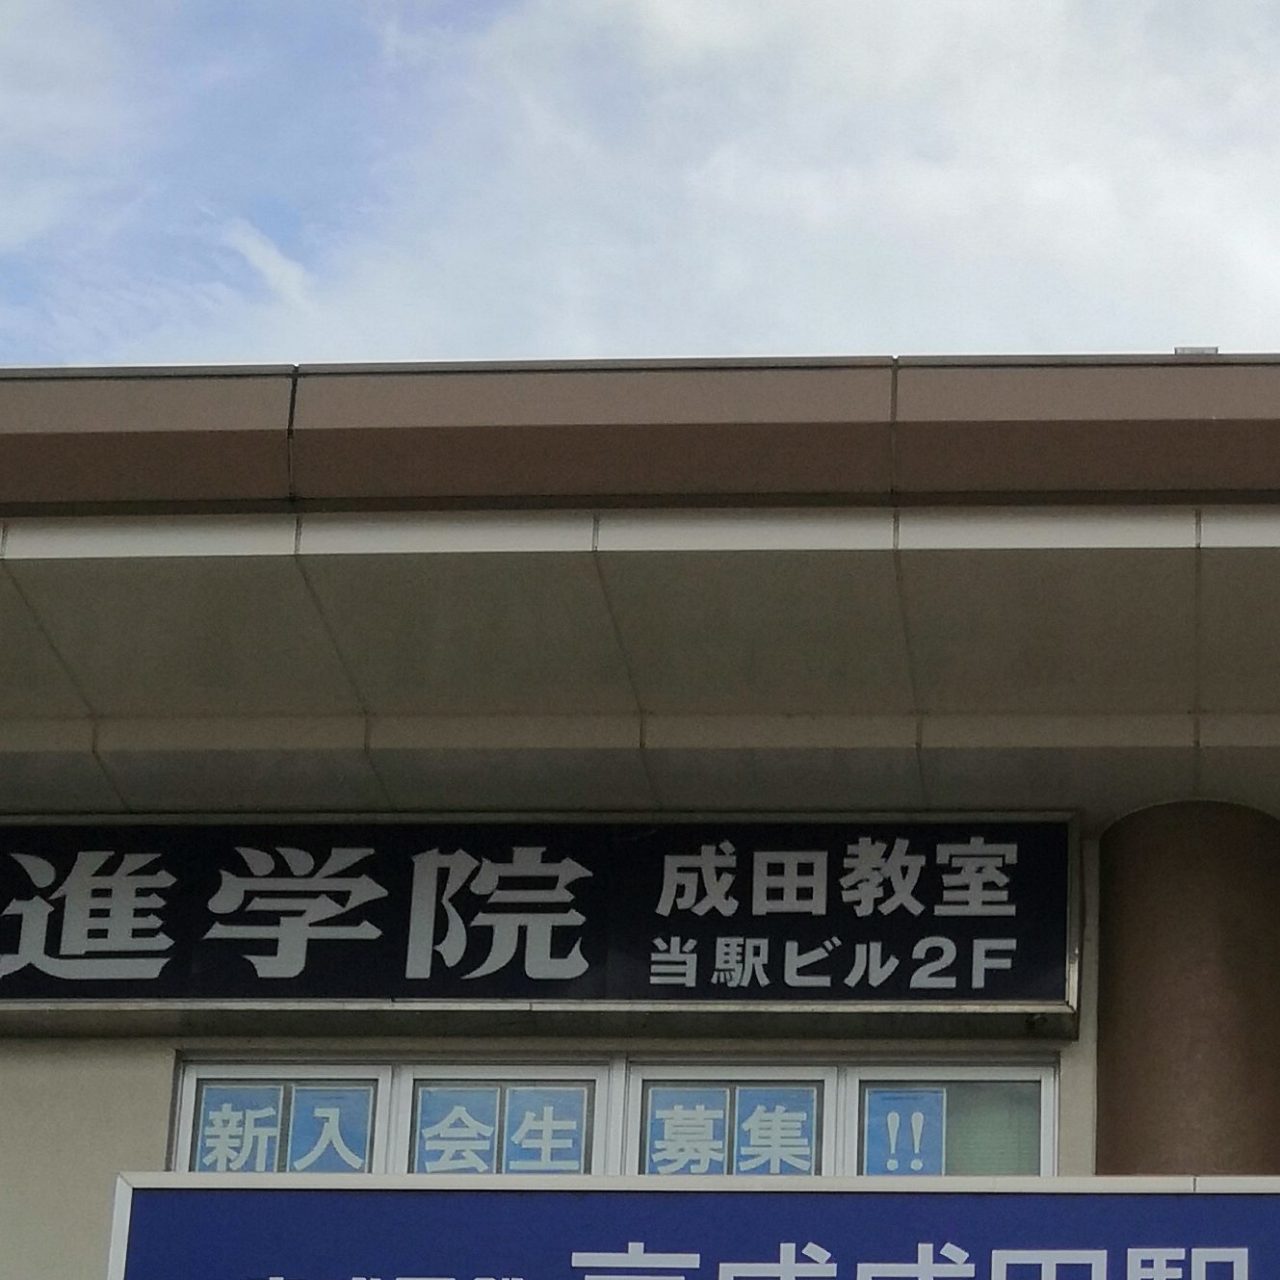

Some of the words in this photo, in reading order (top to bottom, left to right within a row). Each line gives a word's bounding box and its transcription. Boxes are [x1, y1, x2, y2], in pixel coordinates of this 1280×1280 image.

[0, 846, 593, 980] 進学院
[654, 837, 1019, 918] 成田教室
[649, 935, 1018, 990] 当駅ビル2F
